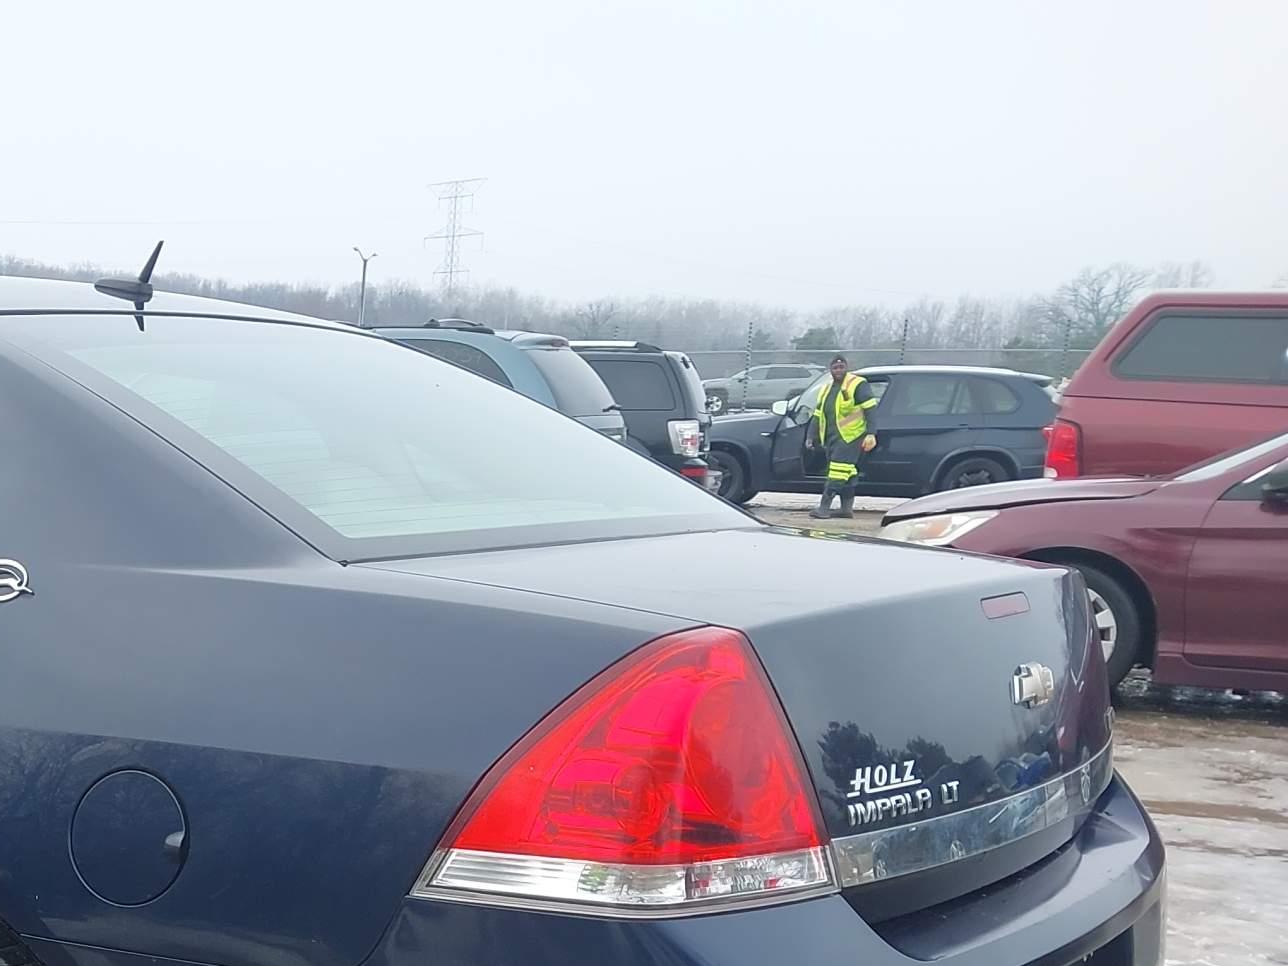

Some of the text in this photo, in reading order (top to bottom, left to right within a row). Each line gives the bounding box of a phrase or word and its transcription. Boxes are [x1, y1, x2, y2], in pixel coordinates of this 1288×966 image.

[848, 760, 920, 796] HOLZ
[847, 780, 960, 827] IMPALA LT
